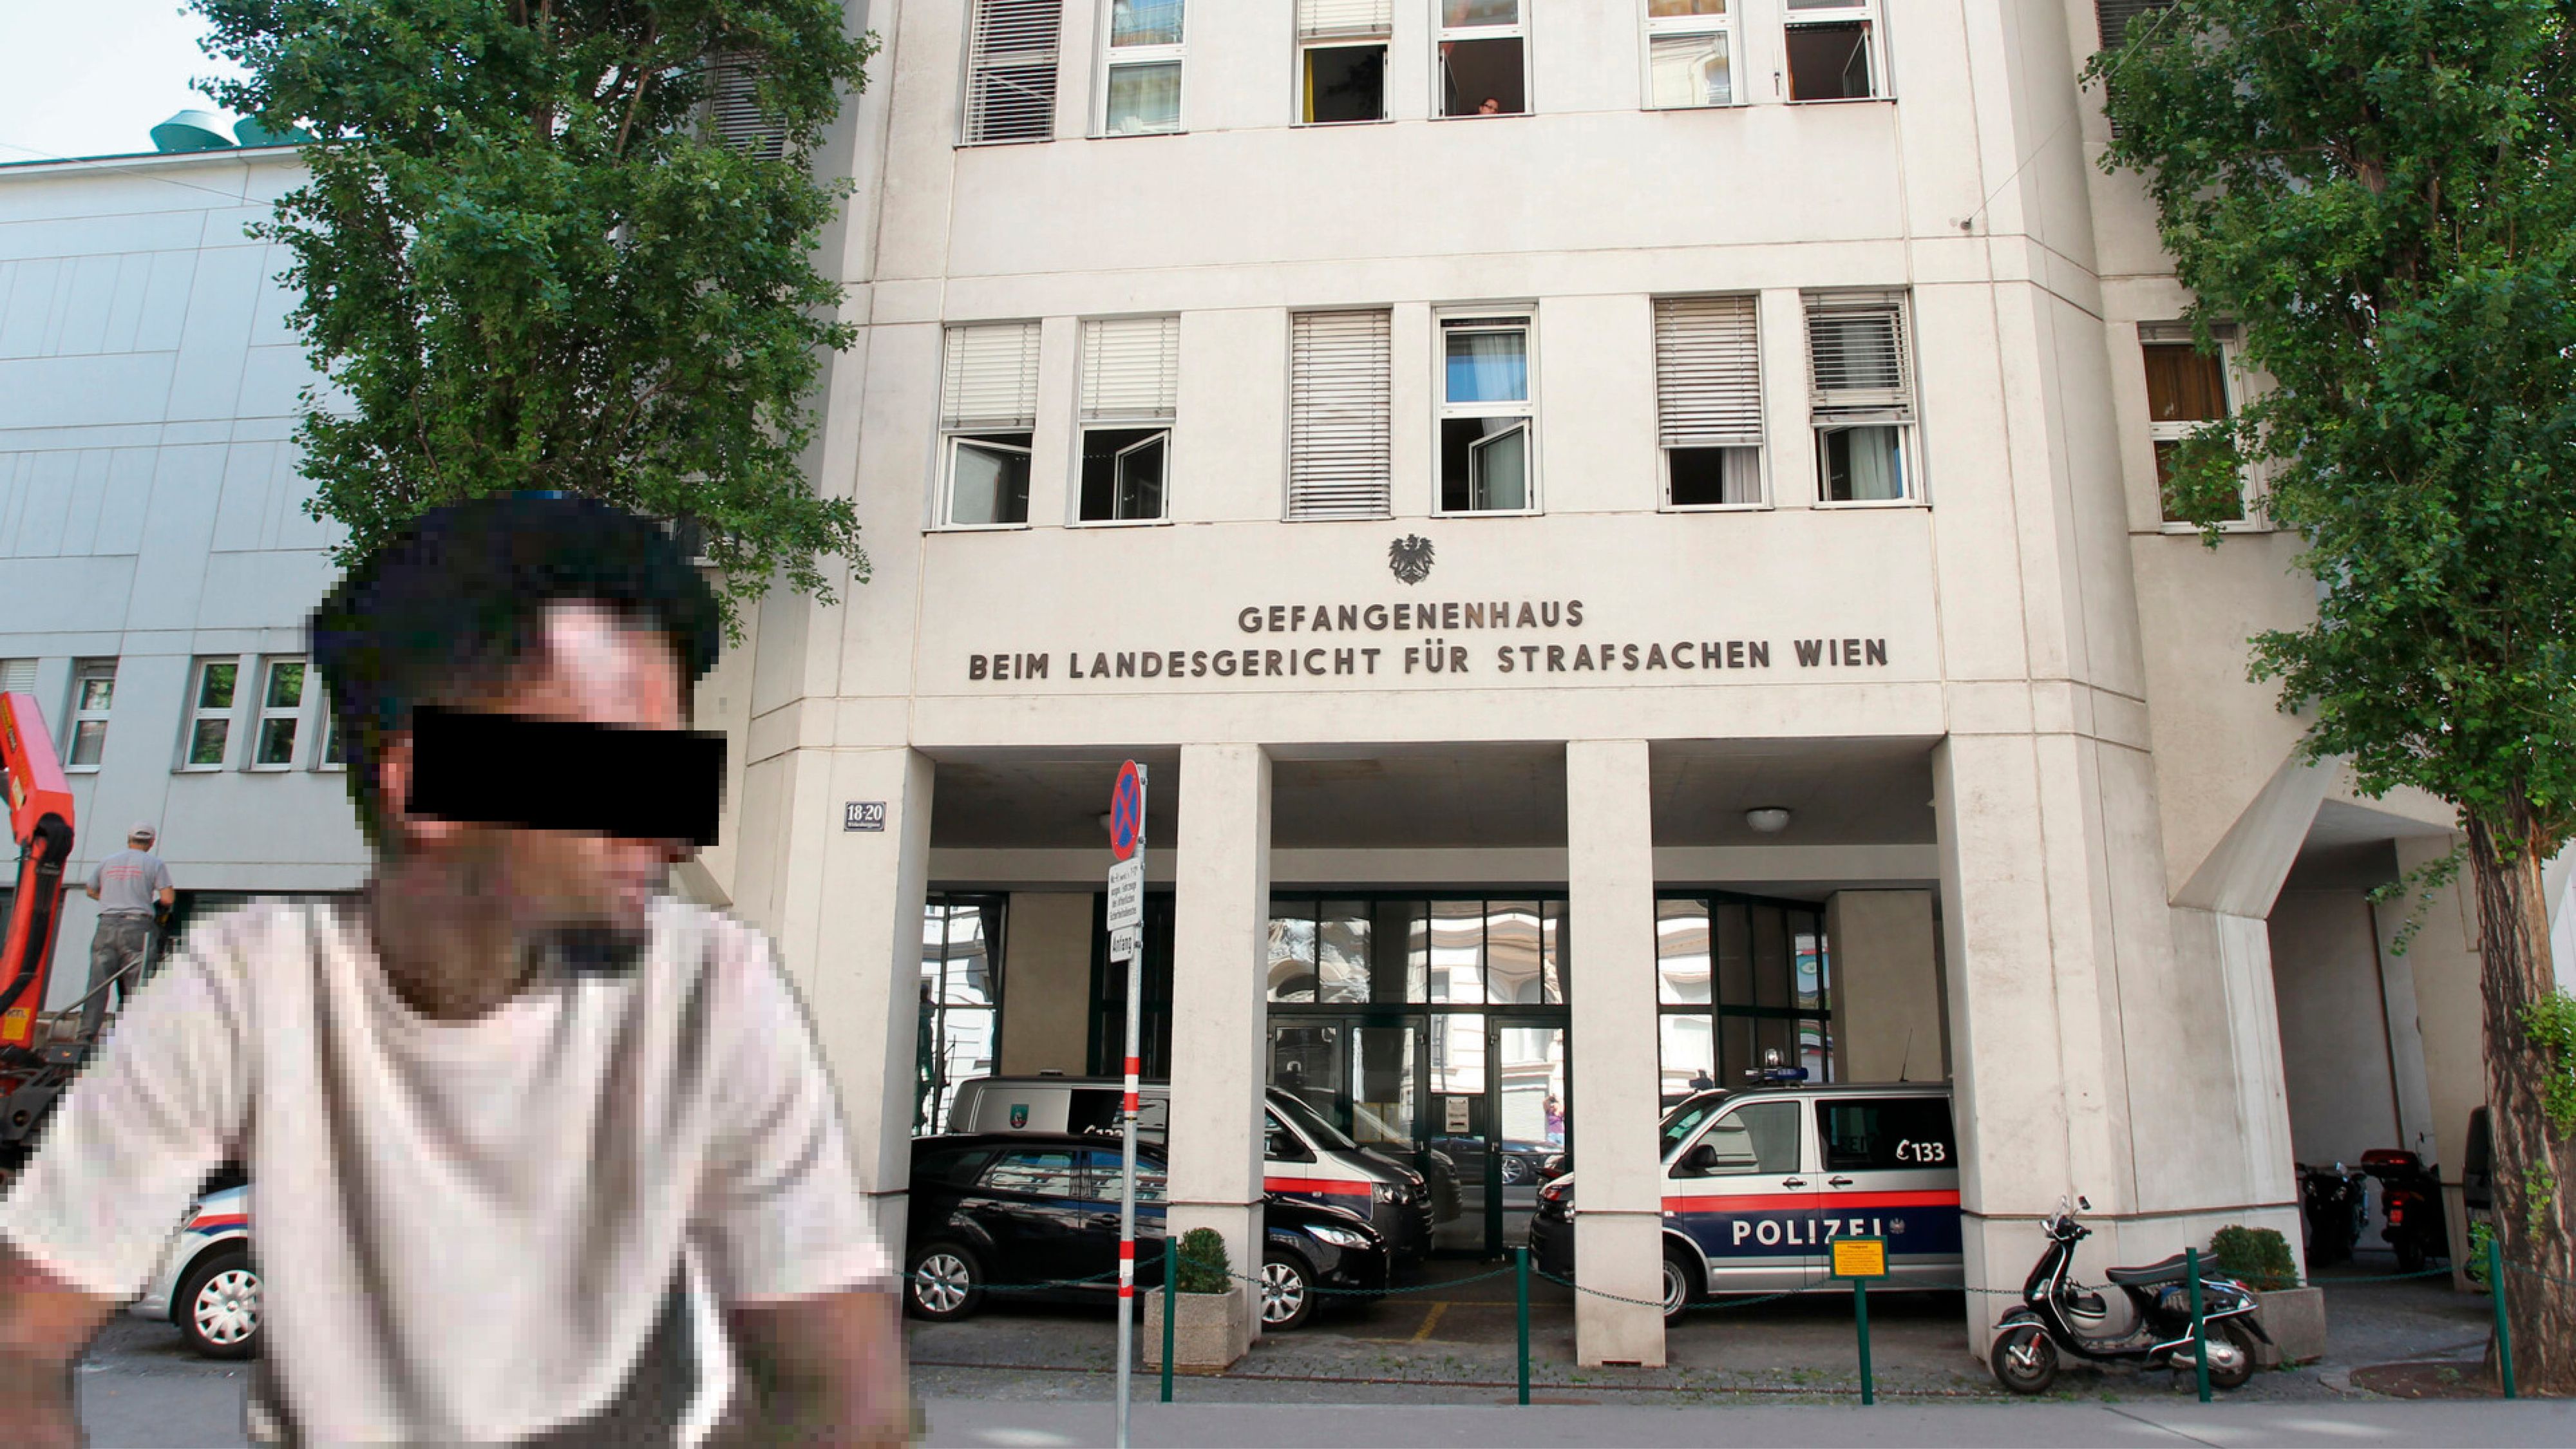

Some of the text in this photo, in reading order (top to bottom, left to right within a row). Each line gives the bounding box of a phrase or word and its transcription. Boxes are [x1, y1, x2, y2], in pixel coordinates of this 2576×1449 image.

[1238, 600, 1584, 633] GEFANGENENHAUS
[969, 638, 1889, 681] BEIM LANDESGERICHT FÜR STRAFSACHEN WIEN
[848, 804, 882, 820] 18-20
[1911, 1142, 1946, 1162] 133
[1732, 1218, 1882, 1245] POLIZEI
